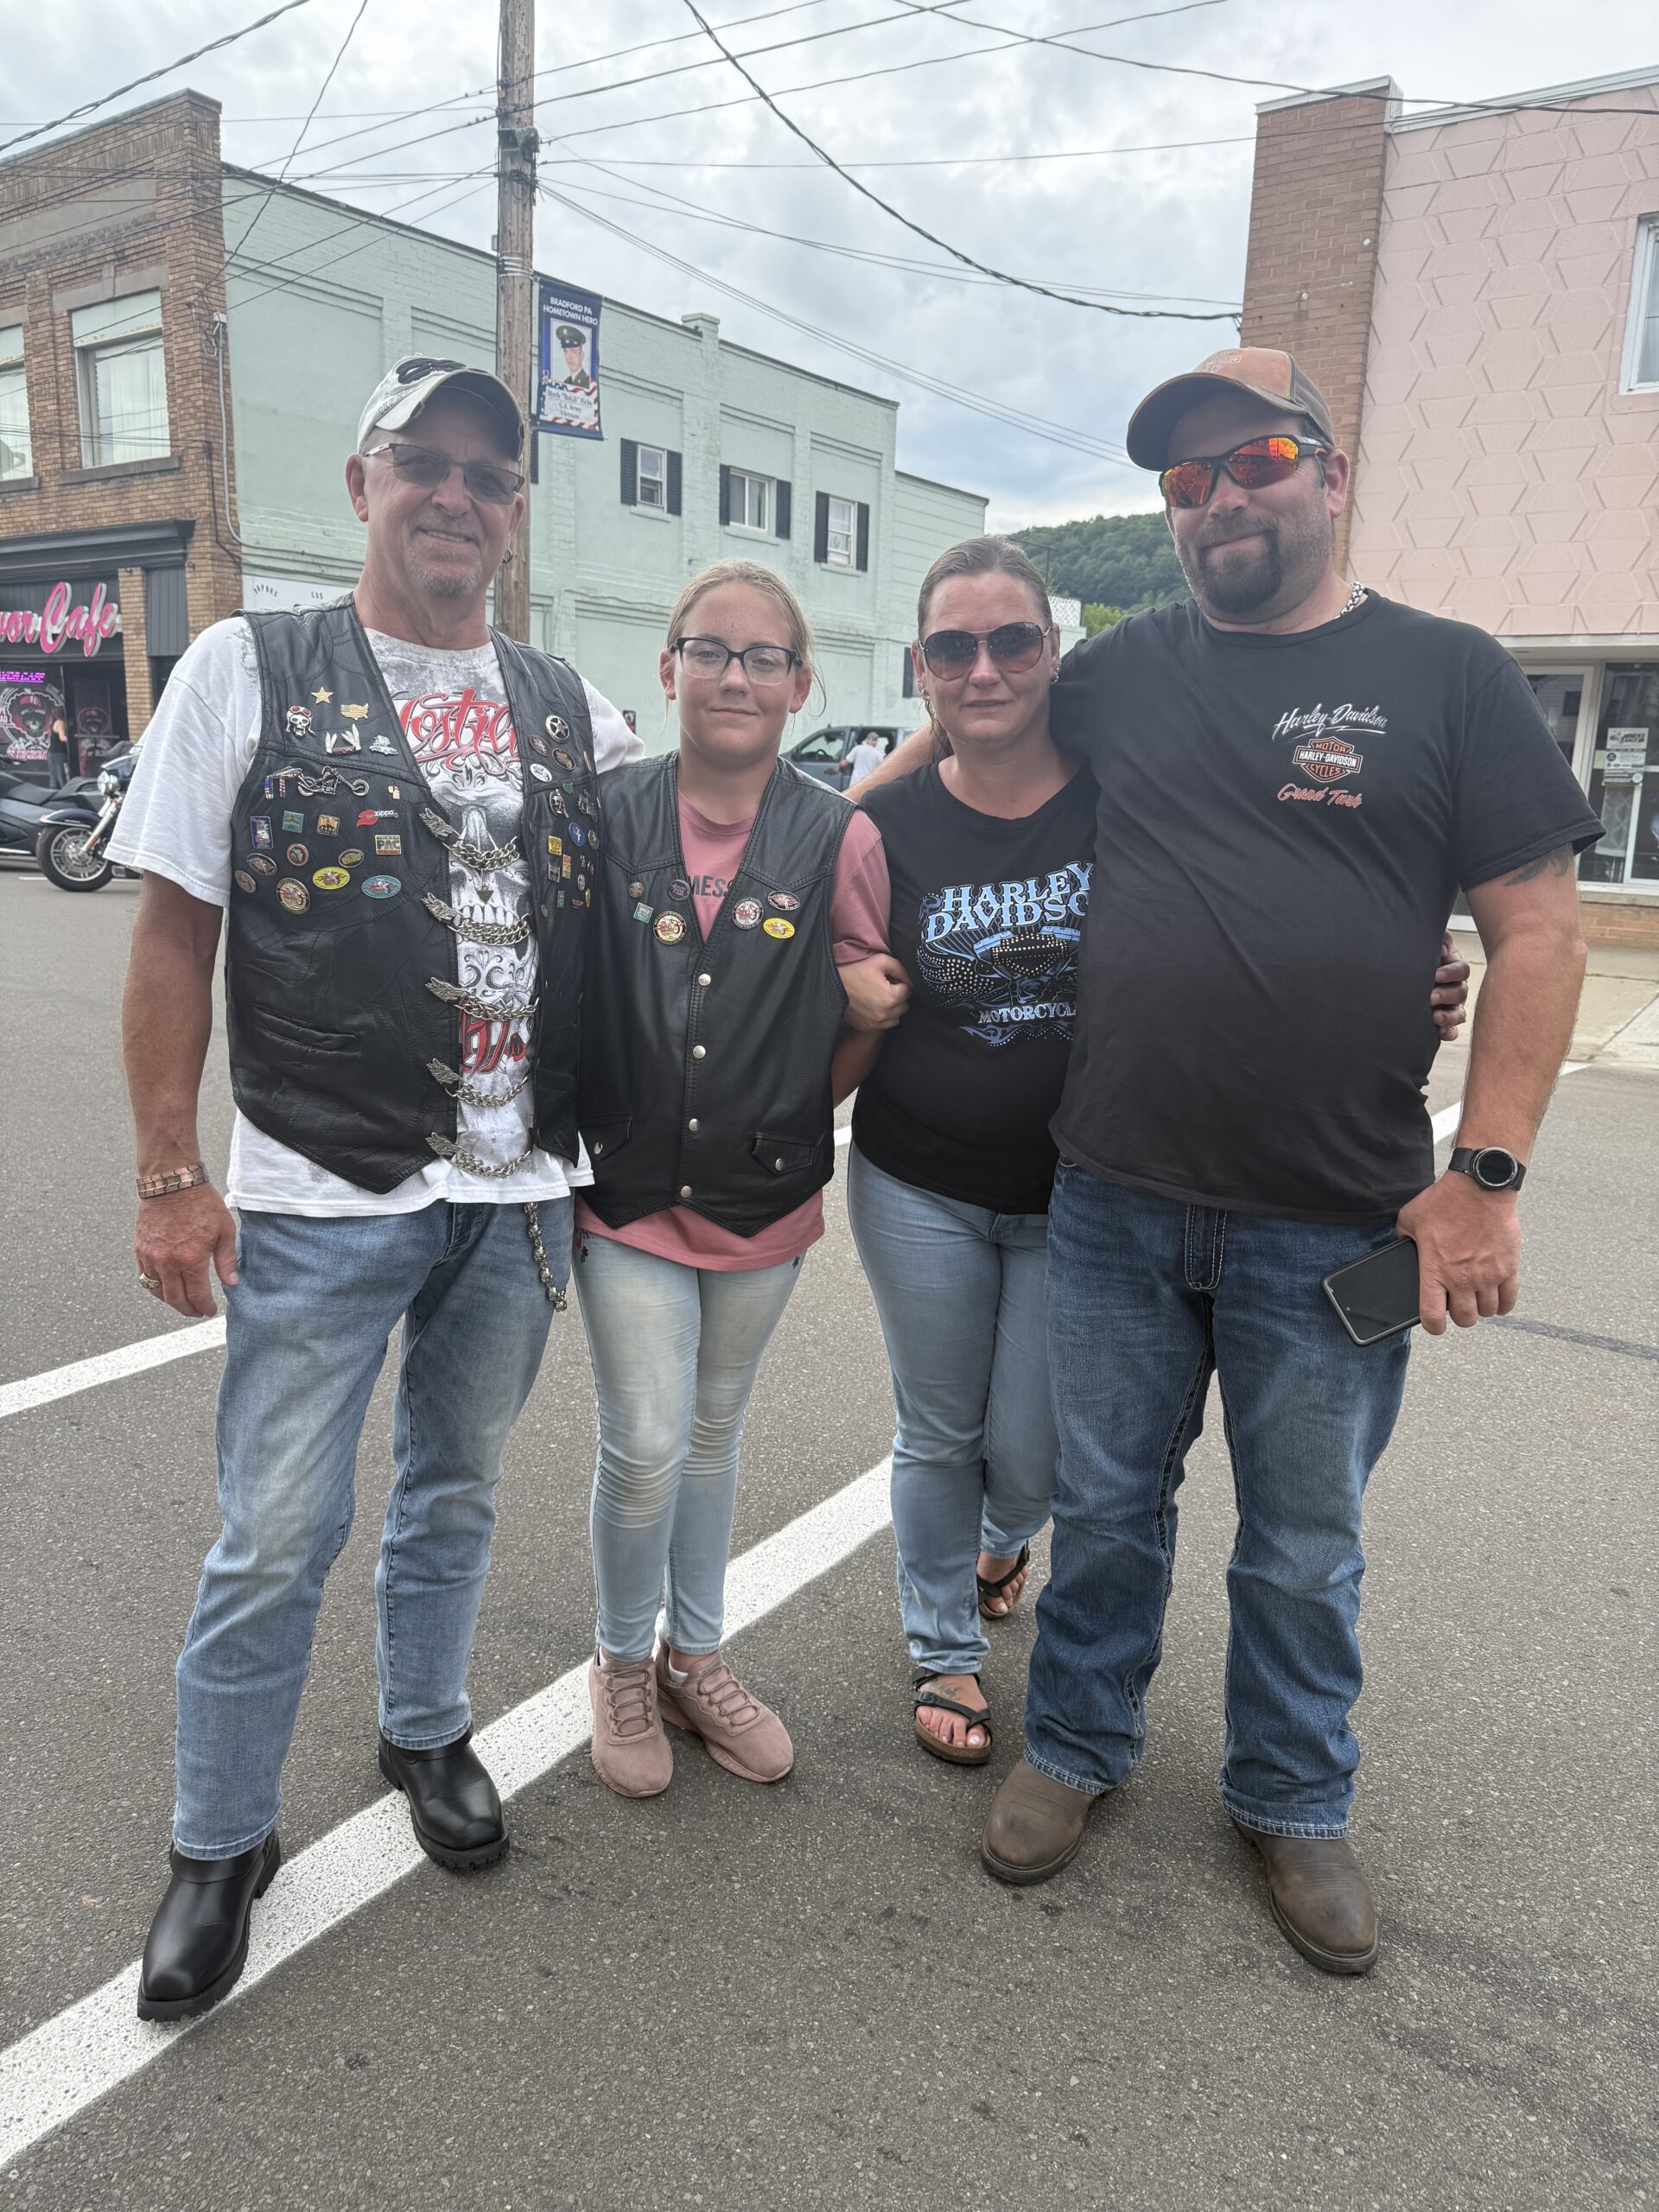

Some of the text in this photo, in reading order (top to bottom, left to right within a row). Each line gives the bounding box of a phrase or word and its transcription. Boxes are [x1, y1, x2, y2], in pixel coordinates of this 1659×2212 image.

[543, 304, 598, 326] HOMETOWN HERO
[550, 296, 593, 315] BRADFORD PA
[560, 410, 581, 420] Vietnam
[40, 582, 118, 657] Cafe
[1272, 703, 1388, 741] Harley-Davidson
[1316, 741, 1346, 753] MOTOR
[1299, 750, 1357, 768] HARLEY-DAVIDSON
[1310, 764, 1341, 778] CYCLES
[1277, 783, 1363, 809] Grand Turk
[940, 861, 1096, 912] HARLEY
